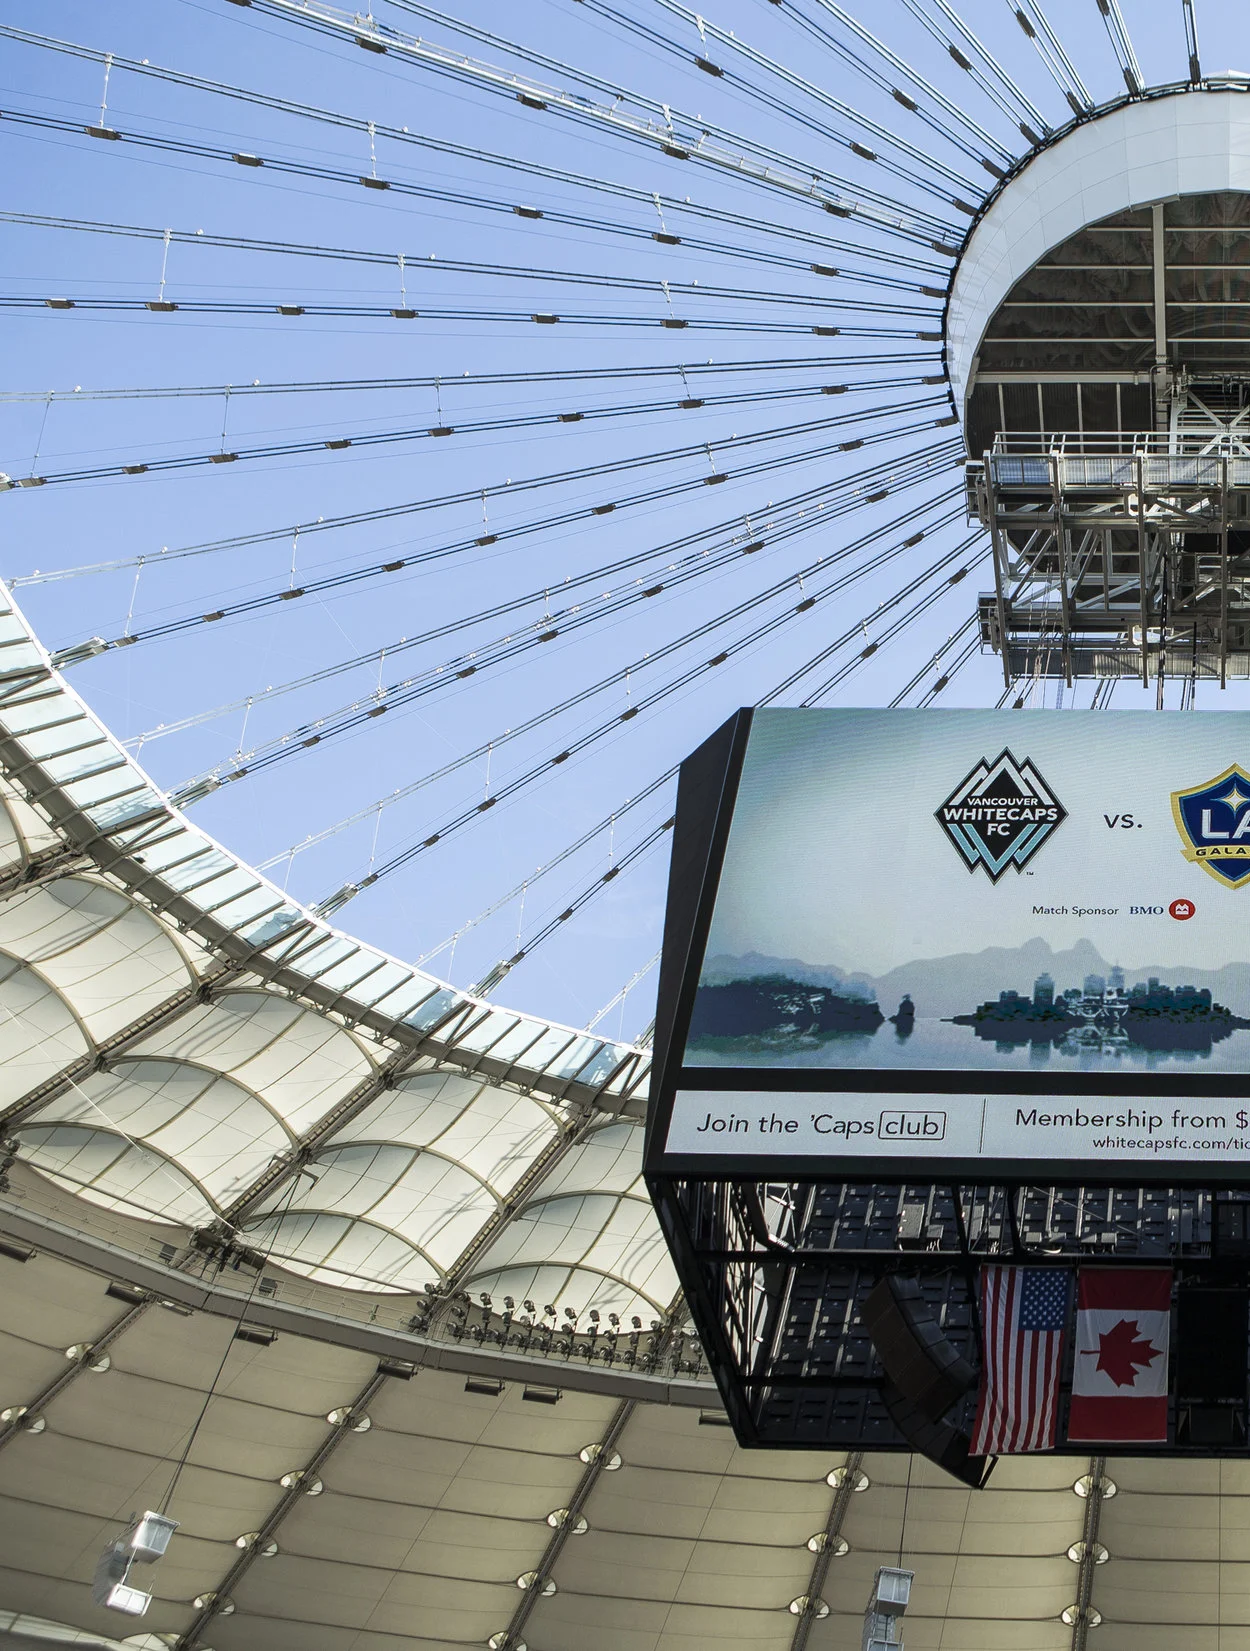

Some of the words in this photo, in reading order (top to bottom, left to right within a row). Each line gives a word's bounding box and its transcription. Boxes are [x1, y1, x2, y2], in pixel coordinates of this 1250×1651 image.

[967, 797, 1038, 806] VANCOUVER
[943, 808, 1058, 822] WHITECAPS
[987, 823, 1011, 836] FC
[1032, 905, 1069, 915] Match
[1071, 905, 1120, 919] Sponsor
[1129, 906, 1164, 915] BMO
[697, 1113, 749, 1133] Join
[758, 1114, 798, 1133] the
[885, 1114, 939, 1136] club
[1016, 1109, 1163, 1133] Membership
[1171, 1110, 1226, 1129] from
